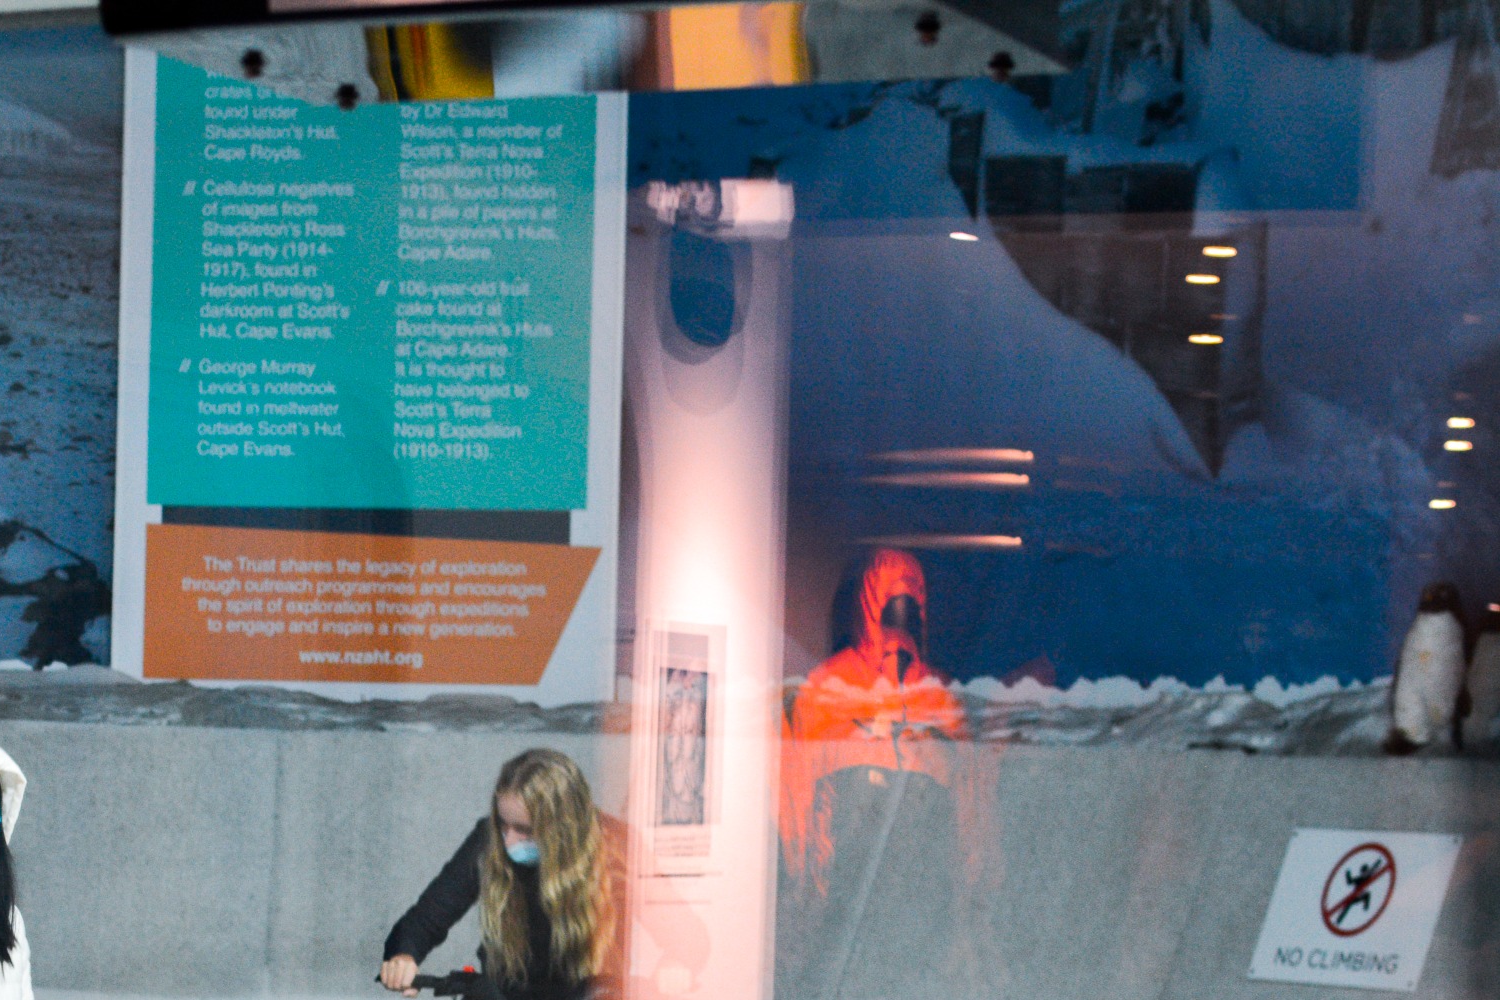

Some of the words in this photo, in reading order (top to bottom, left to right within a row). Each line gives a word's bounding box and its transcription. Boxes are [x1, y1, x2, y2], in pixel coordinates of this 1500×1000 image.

[204, 105, 248, 119] found
[253, 106, 298, 119] under
[401, 105, 420, 120] by
[448, 105, 508, 119] Edward
[204, 124, 303, 140] Shackleton's
[462, 126, 473, 138] a
[477, 125, 543, 138] member
[547, 124, 563, 138] of
[204, 144, 246, 161] Cape
[401, 143, 453, 159] Scott's
[460, 143, 498, 159] Terra
[502, 144, 544, 159] Nova
[203, 179, 275, 197] Cellulose
[279, 181, 354, 199] negatives
[453, 185, 498, 199] found
[202, 201, 218, 216] of
[222, 204, 279, 220] images
[282, 202, 318, 216] from
[399, 204, 413, 219] in
[417, 207, 427, 219] a
[463, 204, 479, 220] of
[542, 206, 557, 220] at
[202, 221, 300, 237] Shackleton's
[305, 221, 345, 237] Ross
[202, 242, 234, 257] Sea
[237, 242, 277, 260] Party
[282, 241, 333, 259] (1914-
[398, 244, 440, 263] Cape
[255, 263, 299, 277] found
[302, 263, 317, 277] in
[201, 282, 259, 297] Herbert
[263, 282, 334, 301] Ponting's
[200, 302, 274, 318] darkroom
[278, 304, 293, 318] at
[298, 302, 350, 319] Scott's
[396, 301, 434, 316] cake
[438, 301, 483, 316] found
[487, 303, 500, 316] at
[236, 322, 278, 340] Cape
[282, 323, 334, 339] Evans.
[516, 322, 553, 337] Huts
[396, 342, 411, 358] at
[415, 340, 457, 360] Cape
[199, 358, 257, 377] George
[261, 359, 316, 378] Murray
[395, 361, 405, 377] It
[409, 363, 422, 376] is
[426, 361, 485, 380] thought
[489, 362, 506, 378] to
[199, 379, 260, 395] Levick's
[264, 380, 337, 395] notebook
[395, 383, 432, 397] have
[437, 383, 510, 402] belonged
[514, 383, 529, 398] to
[198, 400, 241, 415] found
[246, 402, 259, 415] in
[264, 402, 339, 416] meltwater
[395, 402, 447, 418] Scott's
[453, 402, 492, 418] Terra
[198, 422, 253, 436] outside
[258, 421, 310, 436] Scott's
[394, 422, 435, 438] Nova
[197, 440, 238, 459] Cape
[244, 440, 295, 456] Evans.
[204, 555, 233, 572] The
[237, 555, 276, 573] Trust
[280, 558, 333, 574] shares
[336, 559, 361, 574] the
[366, 559, 416, 578] legacy
[421, 558, 437, 574] of
[440, 560, 527, 578] exploration
[182, 577, 242, 596] through
[245, 578, 312, 593] outreach
[317, 581, 415, 597] programmes
[420, 581, 450, 595] and
[454, 584, 547, 600] encourages
[198, 597, 222, 612] the
[226, 599, 263, 615] spirit
[267, 598, 282, 613] of
[286, 599, 372, 616] exploration
[376, 601, 436, 619] through
[440, 602, 530, 618] expeditions
[208, 618, 222, 632] to
[226, 620, 285, 637] engage
[289, 620, 318, 634] and
[322, 620, 374, 636] inspire
[379, 624, 389, 636] a
[394, 624, 425, 636] new
[430, 623, 515, 640] generation.
[299, 650, 423, 669] www.nzaht.org
[1274, 947, 1302, 967] NO
[1307, 949, 1399, 974] CLIMBING
